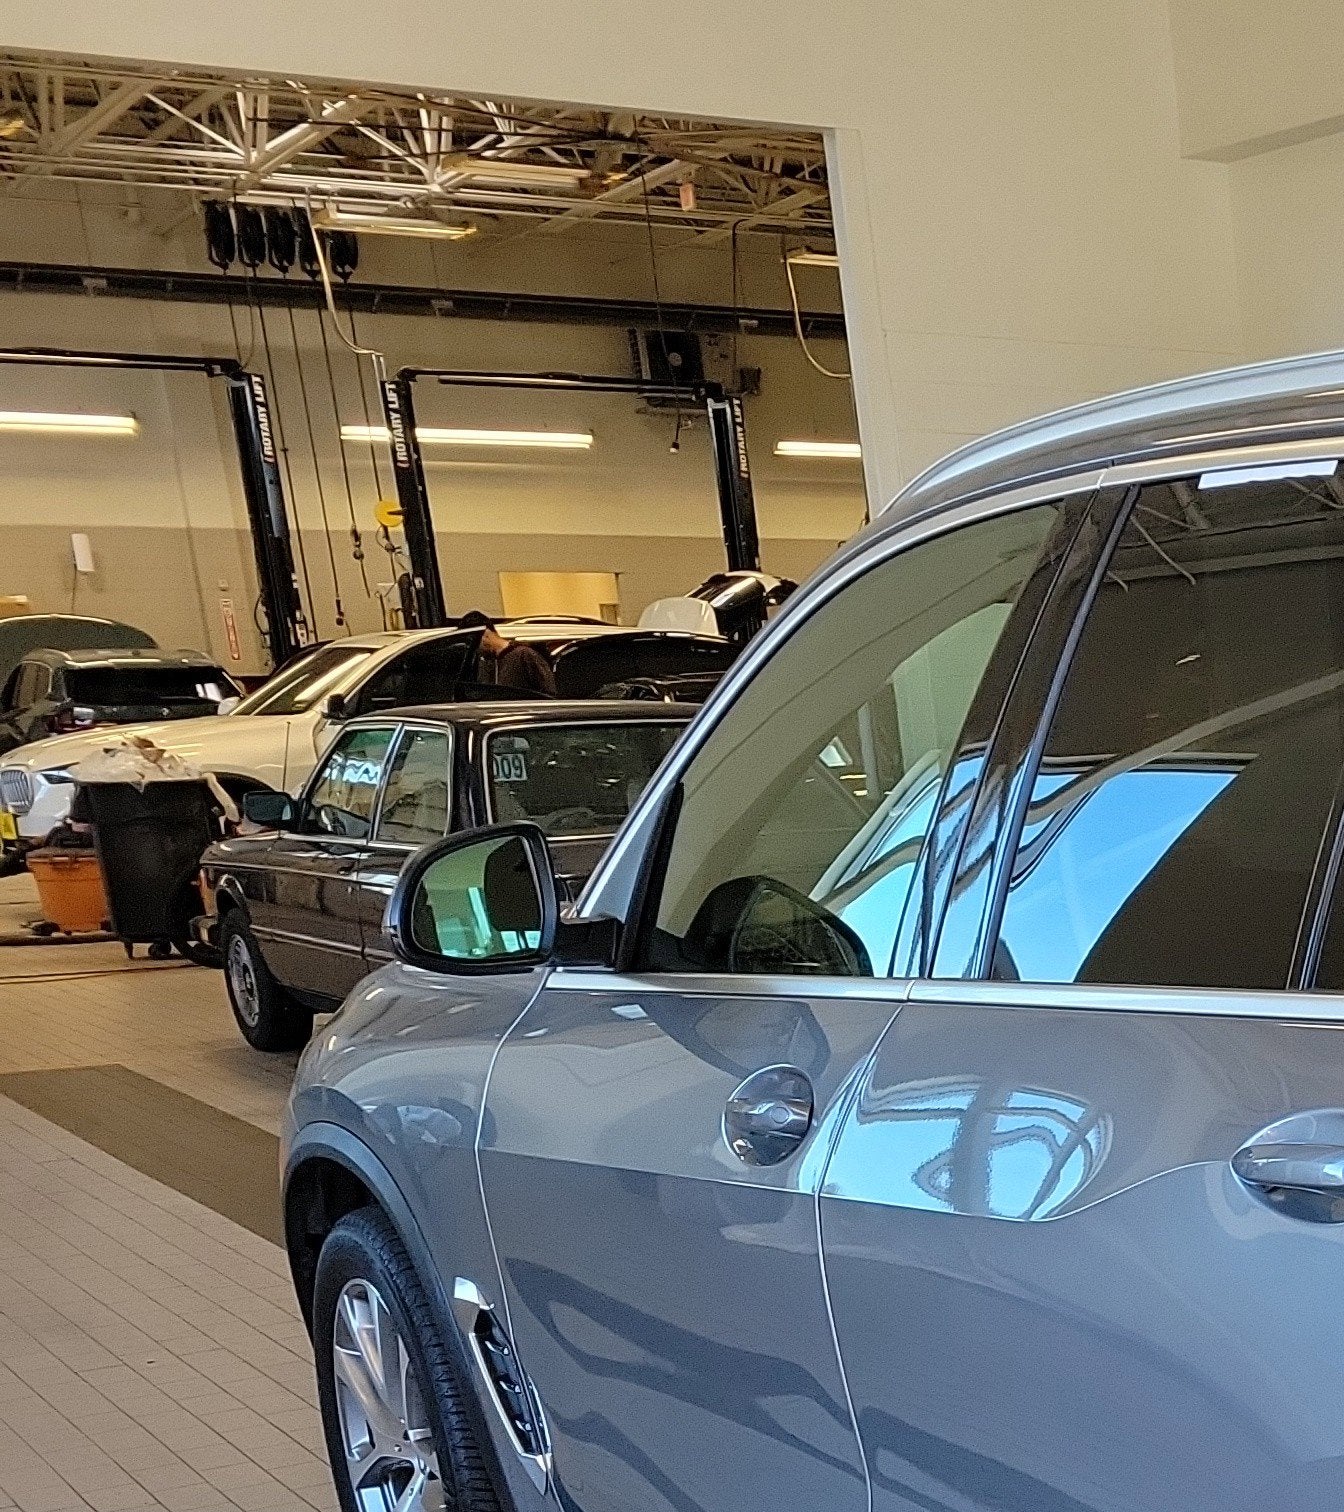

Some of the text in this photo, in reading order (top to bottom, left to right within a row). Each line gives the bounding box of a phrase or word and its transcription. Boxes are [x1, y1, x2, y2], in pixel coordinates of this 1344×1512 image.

[251, 374, 275, 456] ROTARY LIFT
[384, 382, 409, 461] ROTARY LIFT
